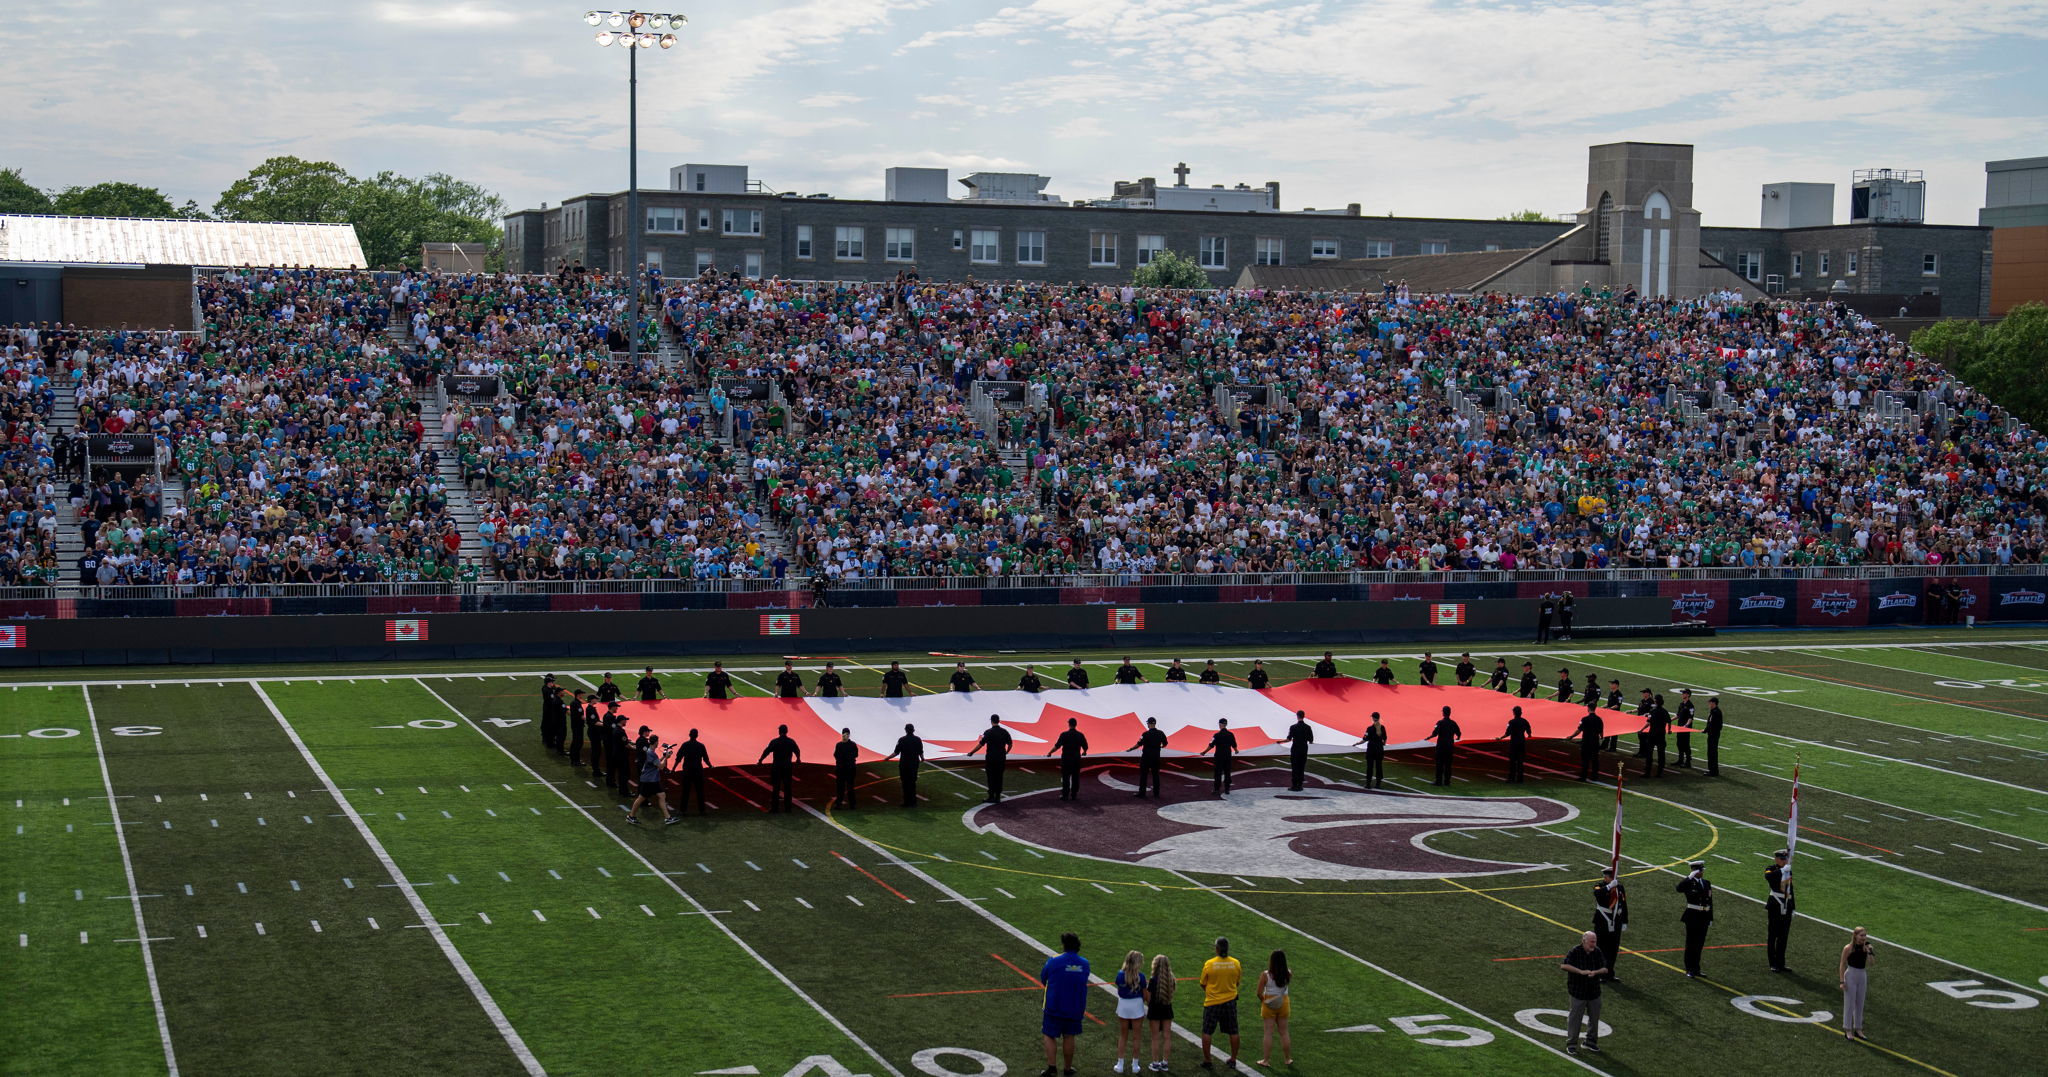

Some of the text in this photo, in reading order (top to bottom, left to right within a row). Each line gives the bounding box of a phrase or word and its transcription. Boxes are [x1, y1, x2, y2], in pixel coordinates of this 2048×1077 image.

[1672, 599, 1715, 610] ATLANTIC
[1739, 598, 1785, 610] ATLANTIC
[1811, 598, 1857, 609] ATLANTIC
[1878, 596, 1916, 609] ATLANTIC
[2000, 593, 2045, 605] ATLANTIC
[1731, 995, 1835, 1024] C
